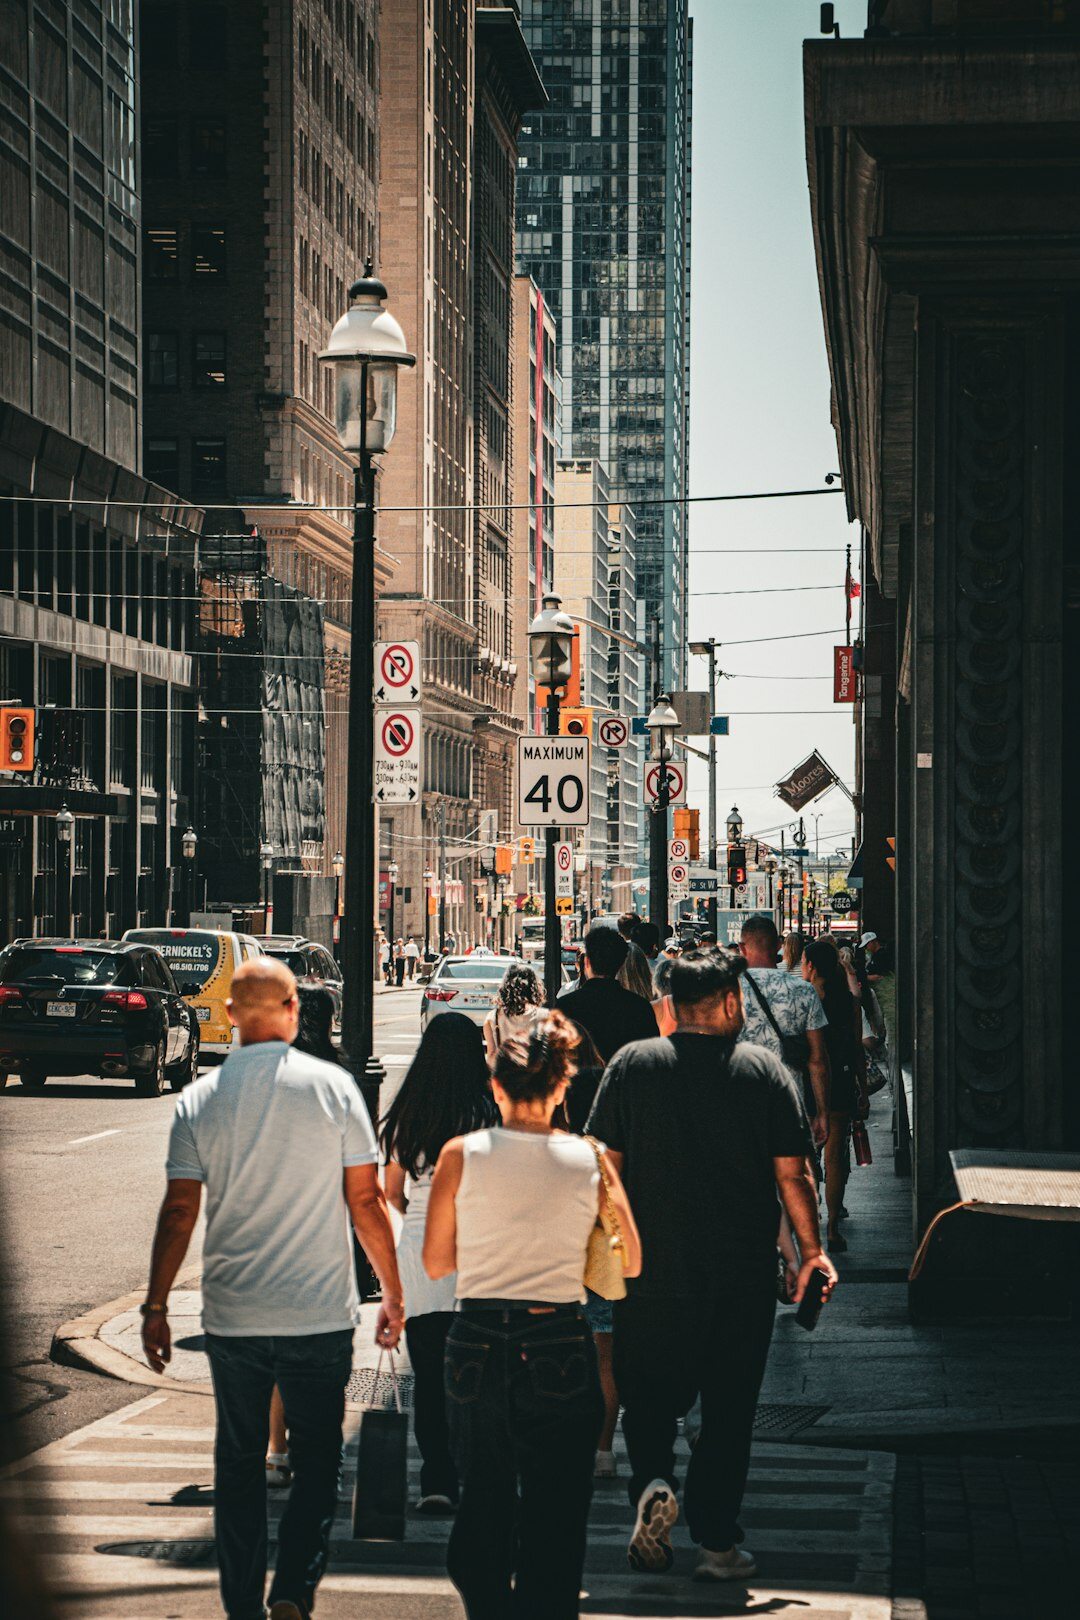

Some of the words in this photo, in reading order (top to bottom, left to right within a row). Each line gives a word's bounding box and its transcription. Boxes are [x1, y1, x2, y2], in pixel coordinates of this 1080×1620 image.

[839, 656, 849, 699] Tangerine
[524, 747, 584, 760] MAXIMUM
[784, 765, 824, 796] Moores
[524, 775, 584, 813] 40
[707, 880, 715, 889] W
[219, 1034, 227, 1042] 10
